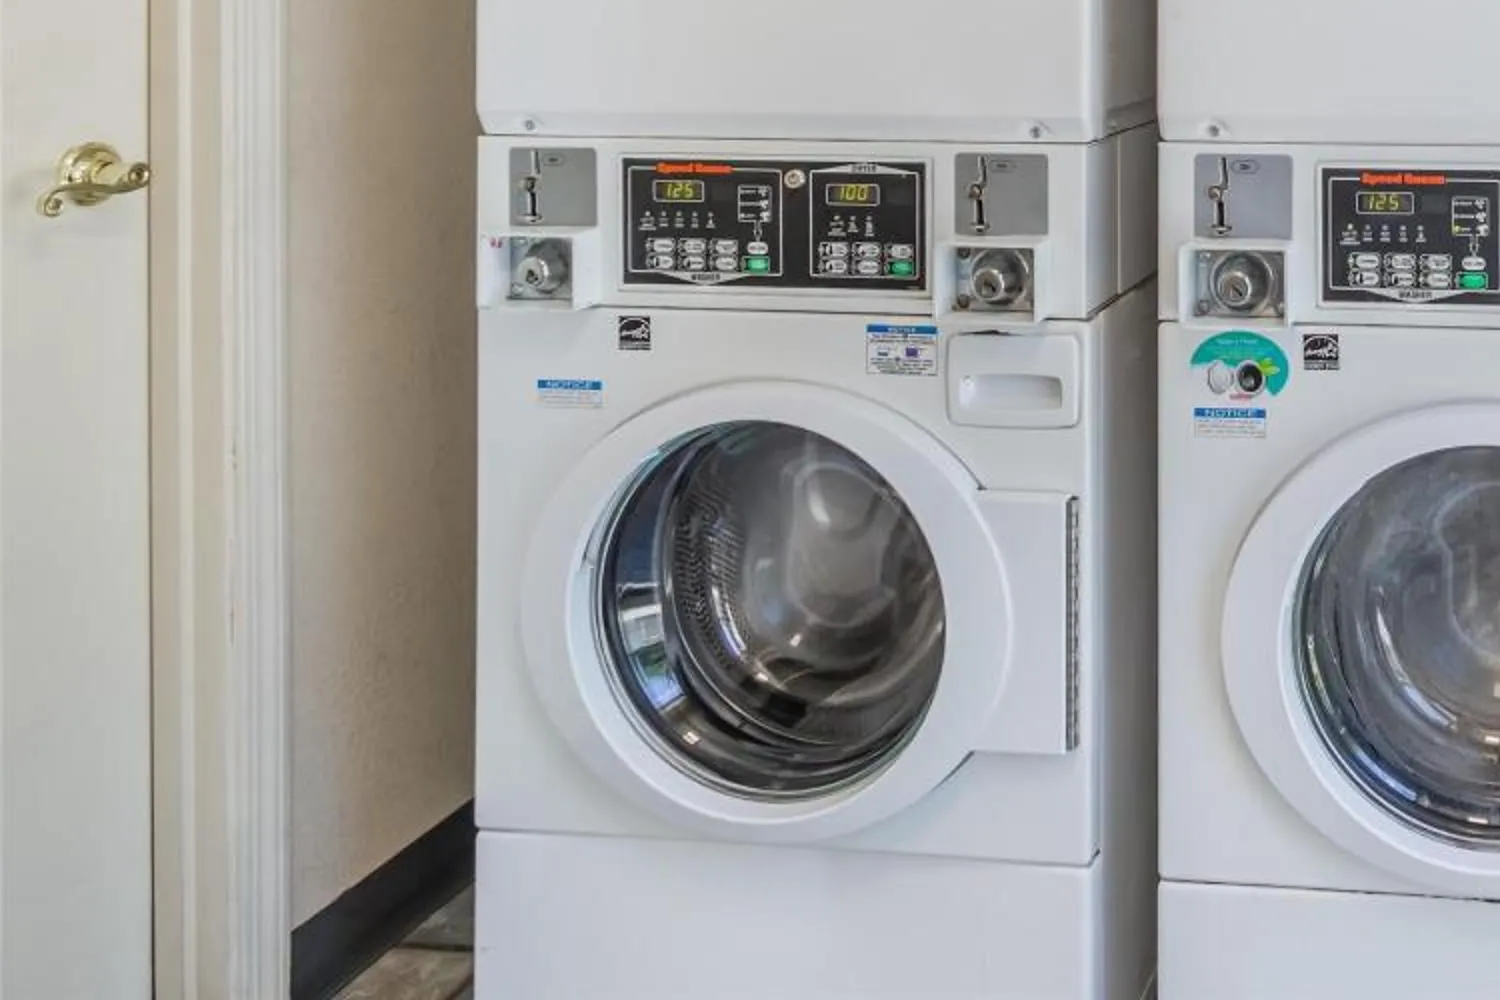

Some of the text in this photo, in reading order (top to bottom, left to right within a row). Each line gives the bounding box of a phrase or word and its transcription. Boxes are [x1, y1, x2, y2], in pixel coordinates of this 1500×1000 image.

[666, 183, 694, 198] 125
[841, 184, 868, 201] 100
[1368, 194, 1399, 210] 125
[1204, 408, 1258, 418] NOTICE
